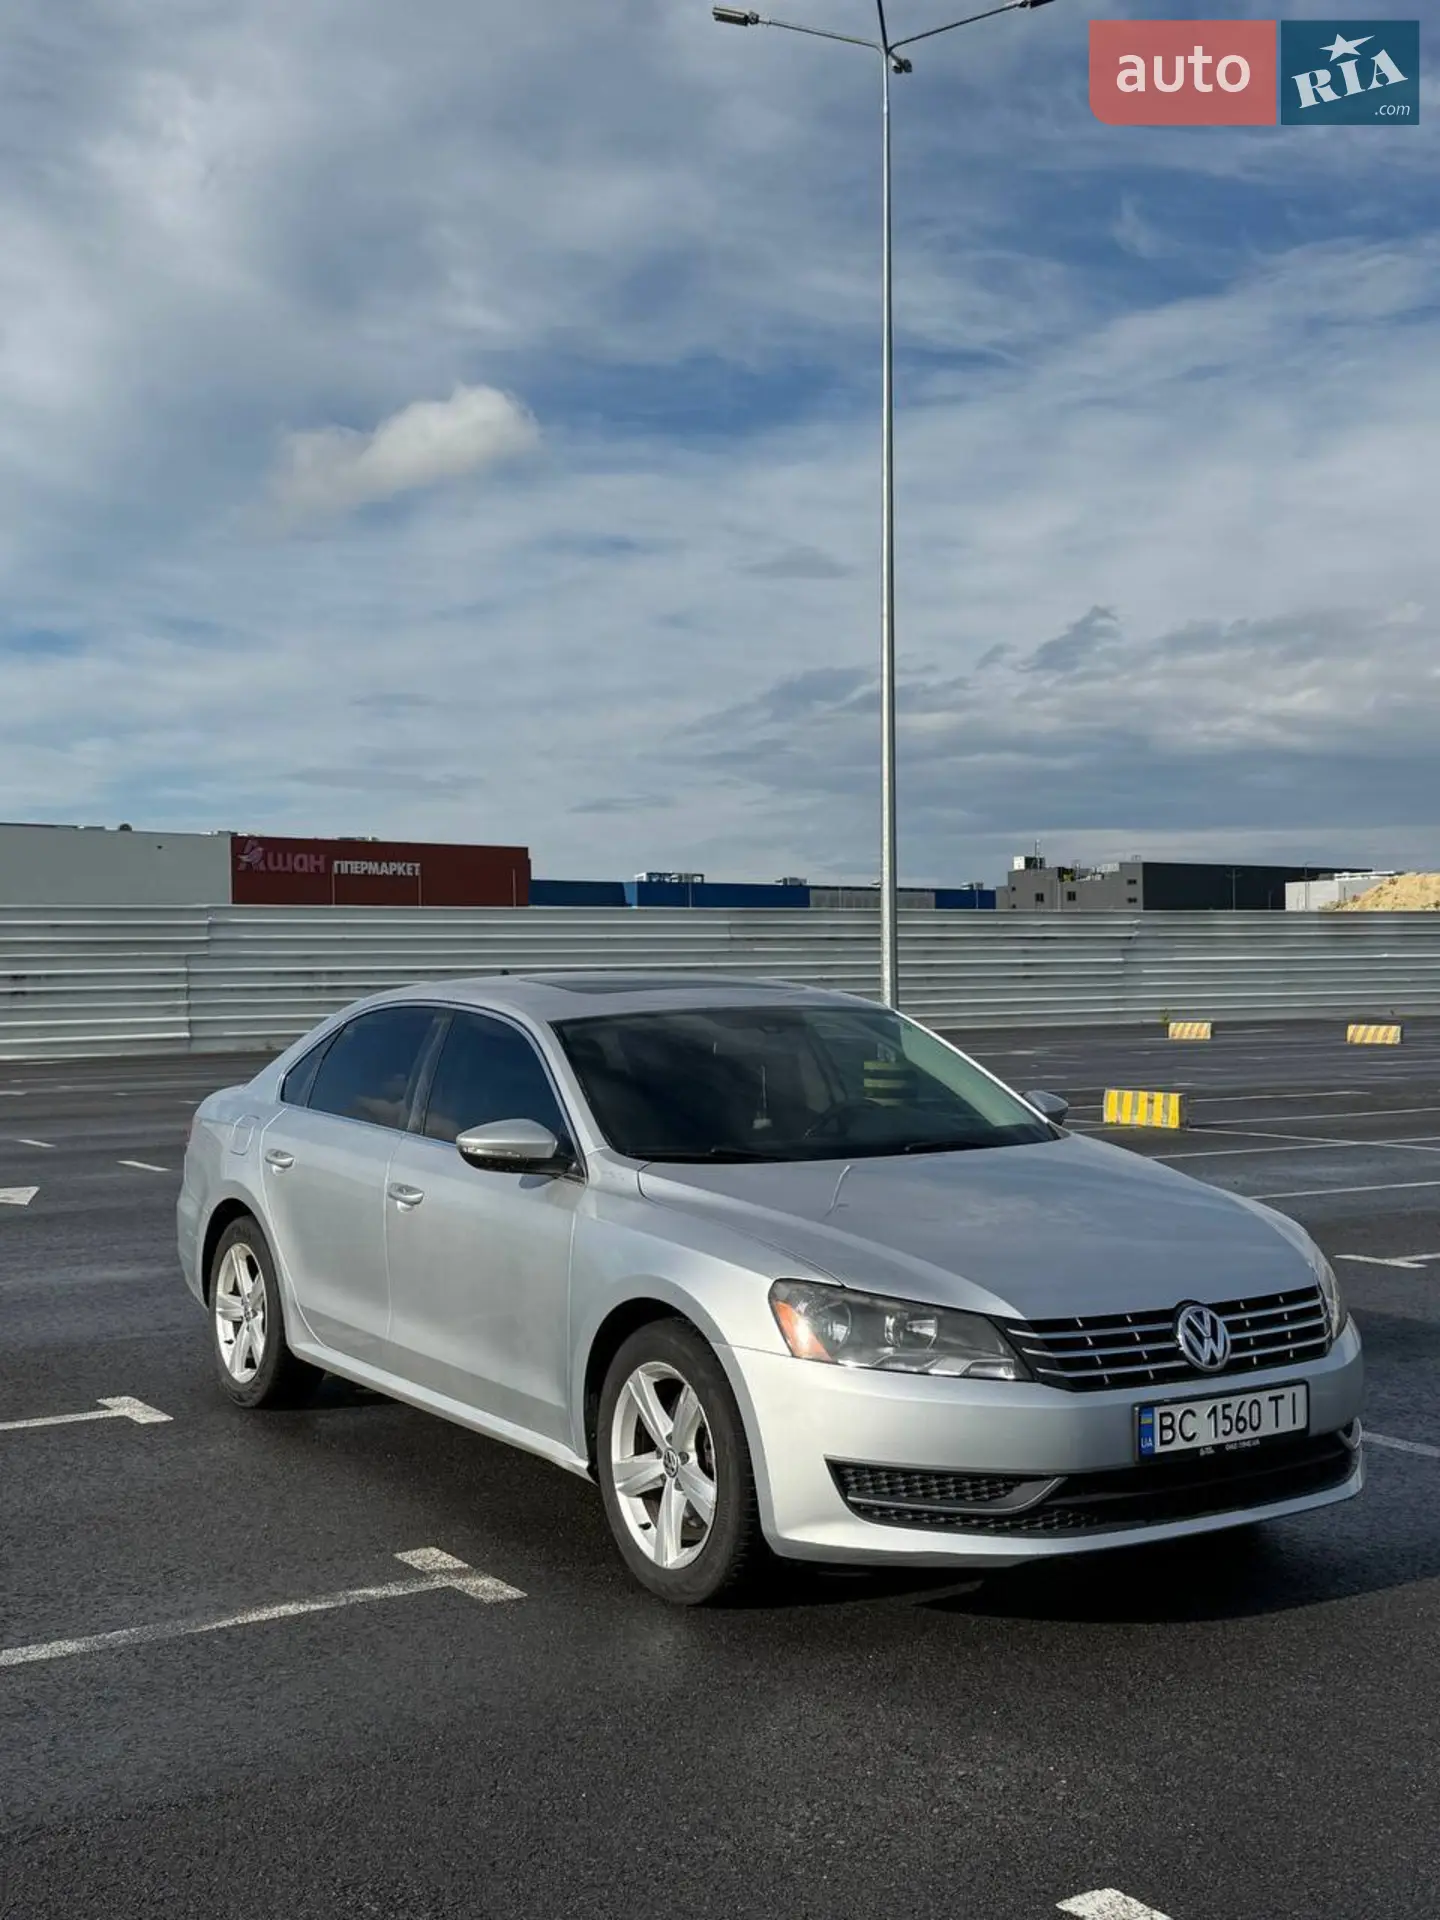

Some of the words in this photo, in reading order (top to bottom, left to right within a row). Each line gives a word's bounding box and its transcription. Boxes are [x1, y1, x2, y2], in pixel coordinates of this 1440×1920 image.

[332, 860, 421, 876] ГІПЕРМАРКЕТ
[1158, 1408, 1197, 1446] BC
[1206, 1399, 1261, 1438] 1560
